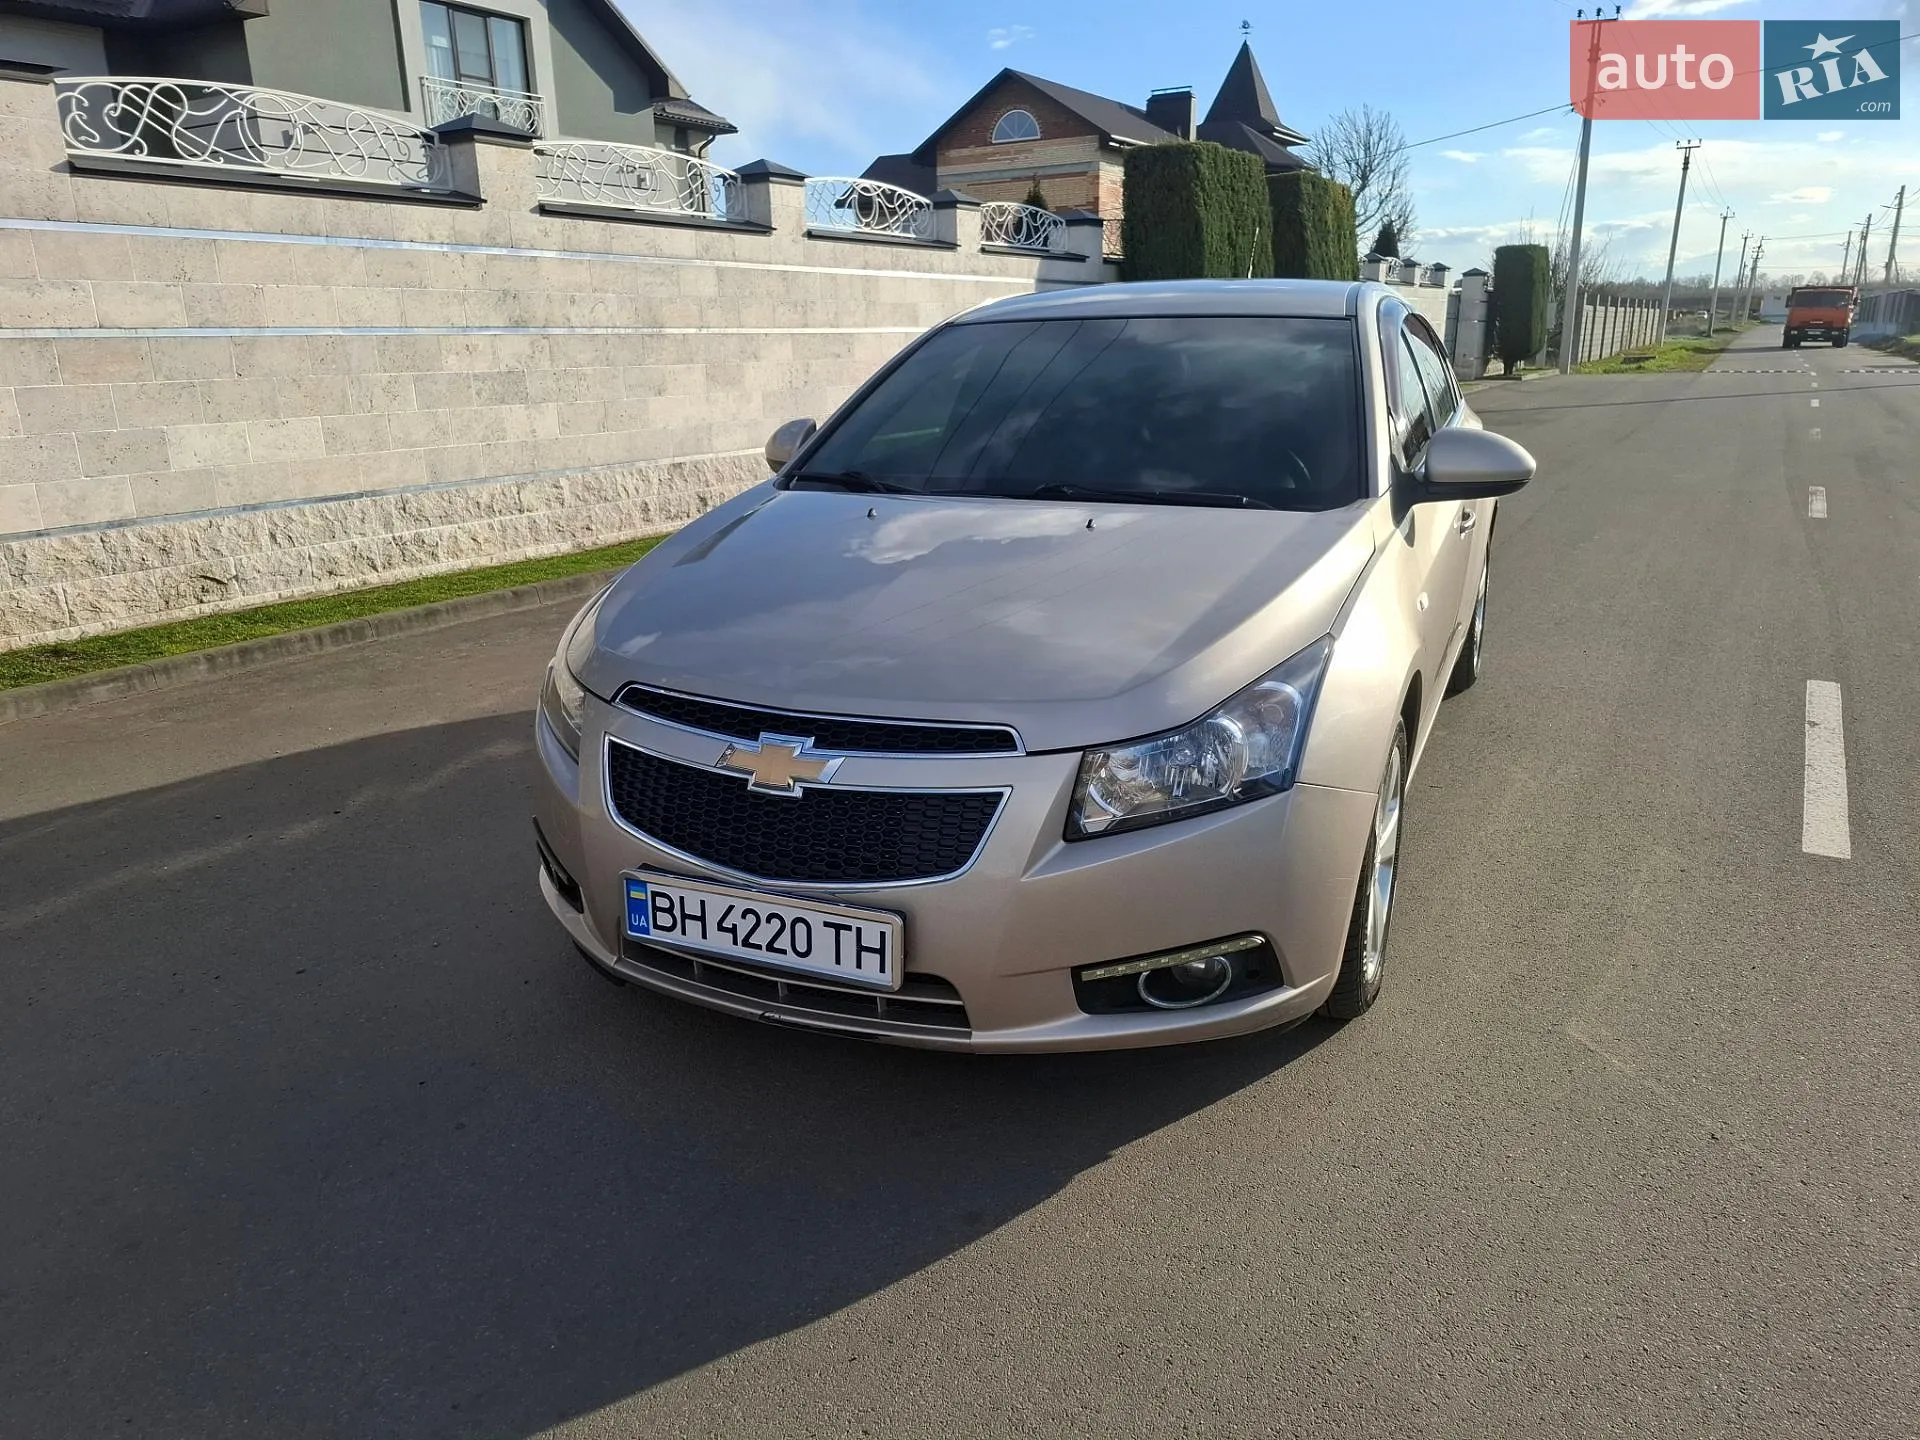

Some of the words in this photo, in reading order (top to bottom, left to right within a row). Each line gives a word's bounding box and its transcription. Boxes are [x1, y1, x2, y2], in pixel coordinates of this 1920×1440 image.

[631, 913, 648, 928] UA
[650, 890, 708, 940] BH
[716, 904, 812, 959] 4220
[823, 920, 887, 974] TH
